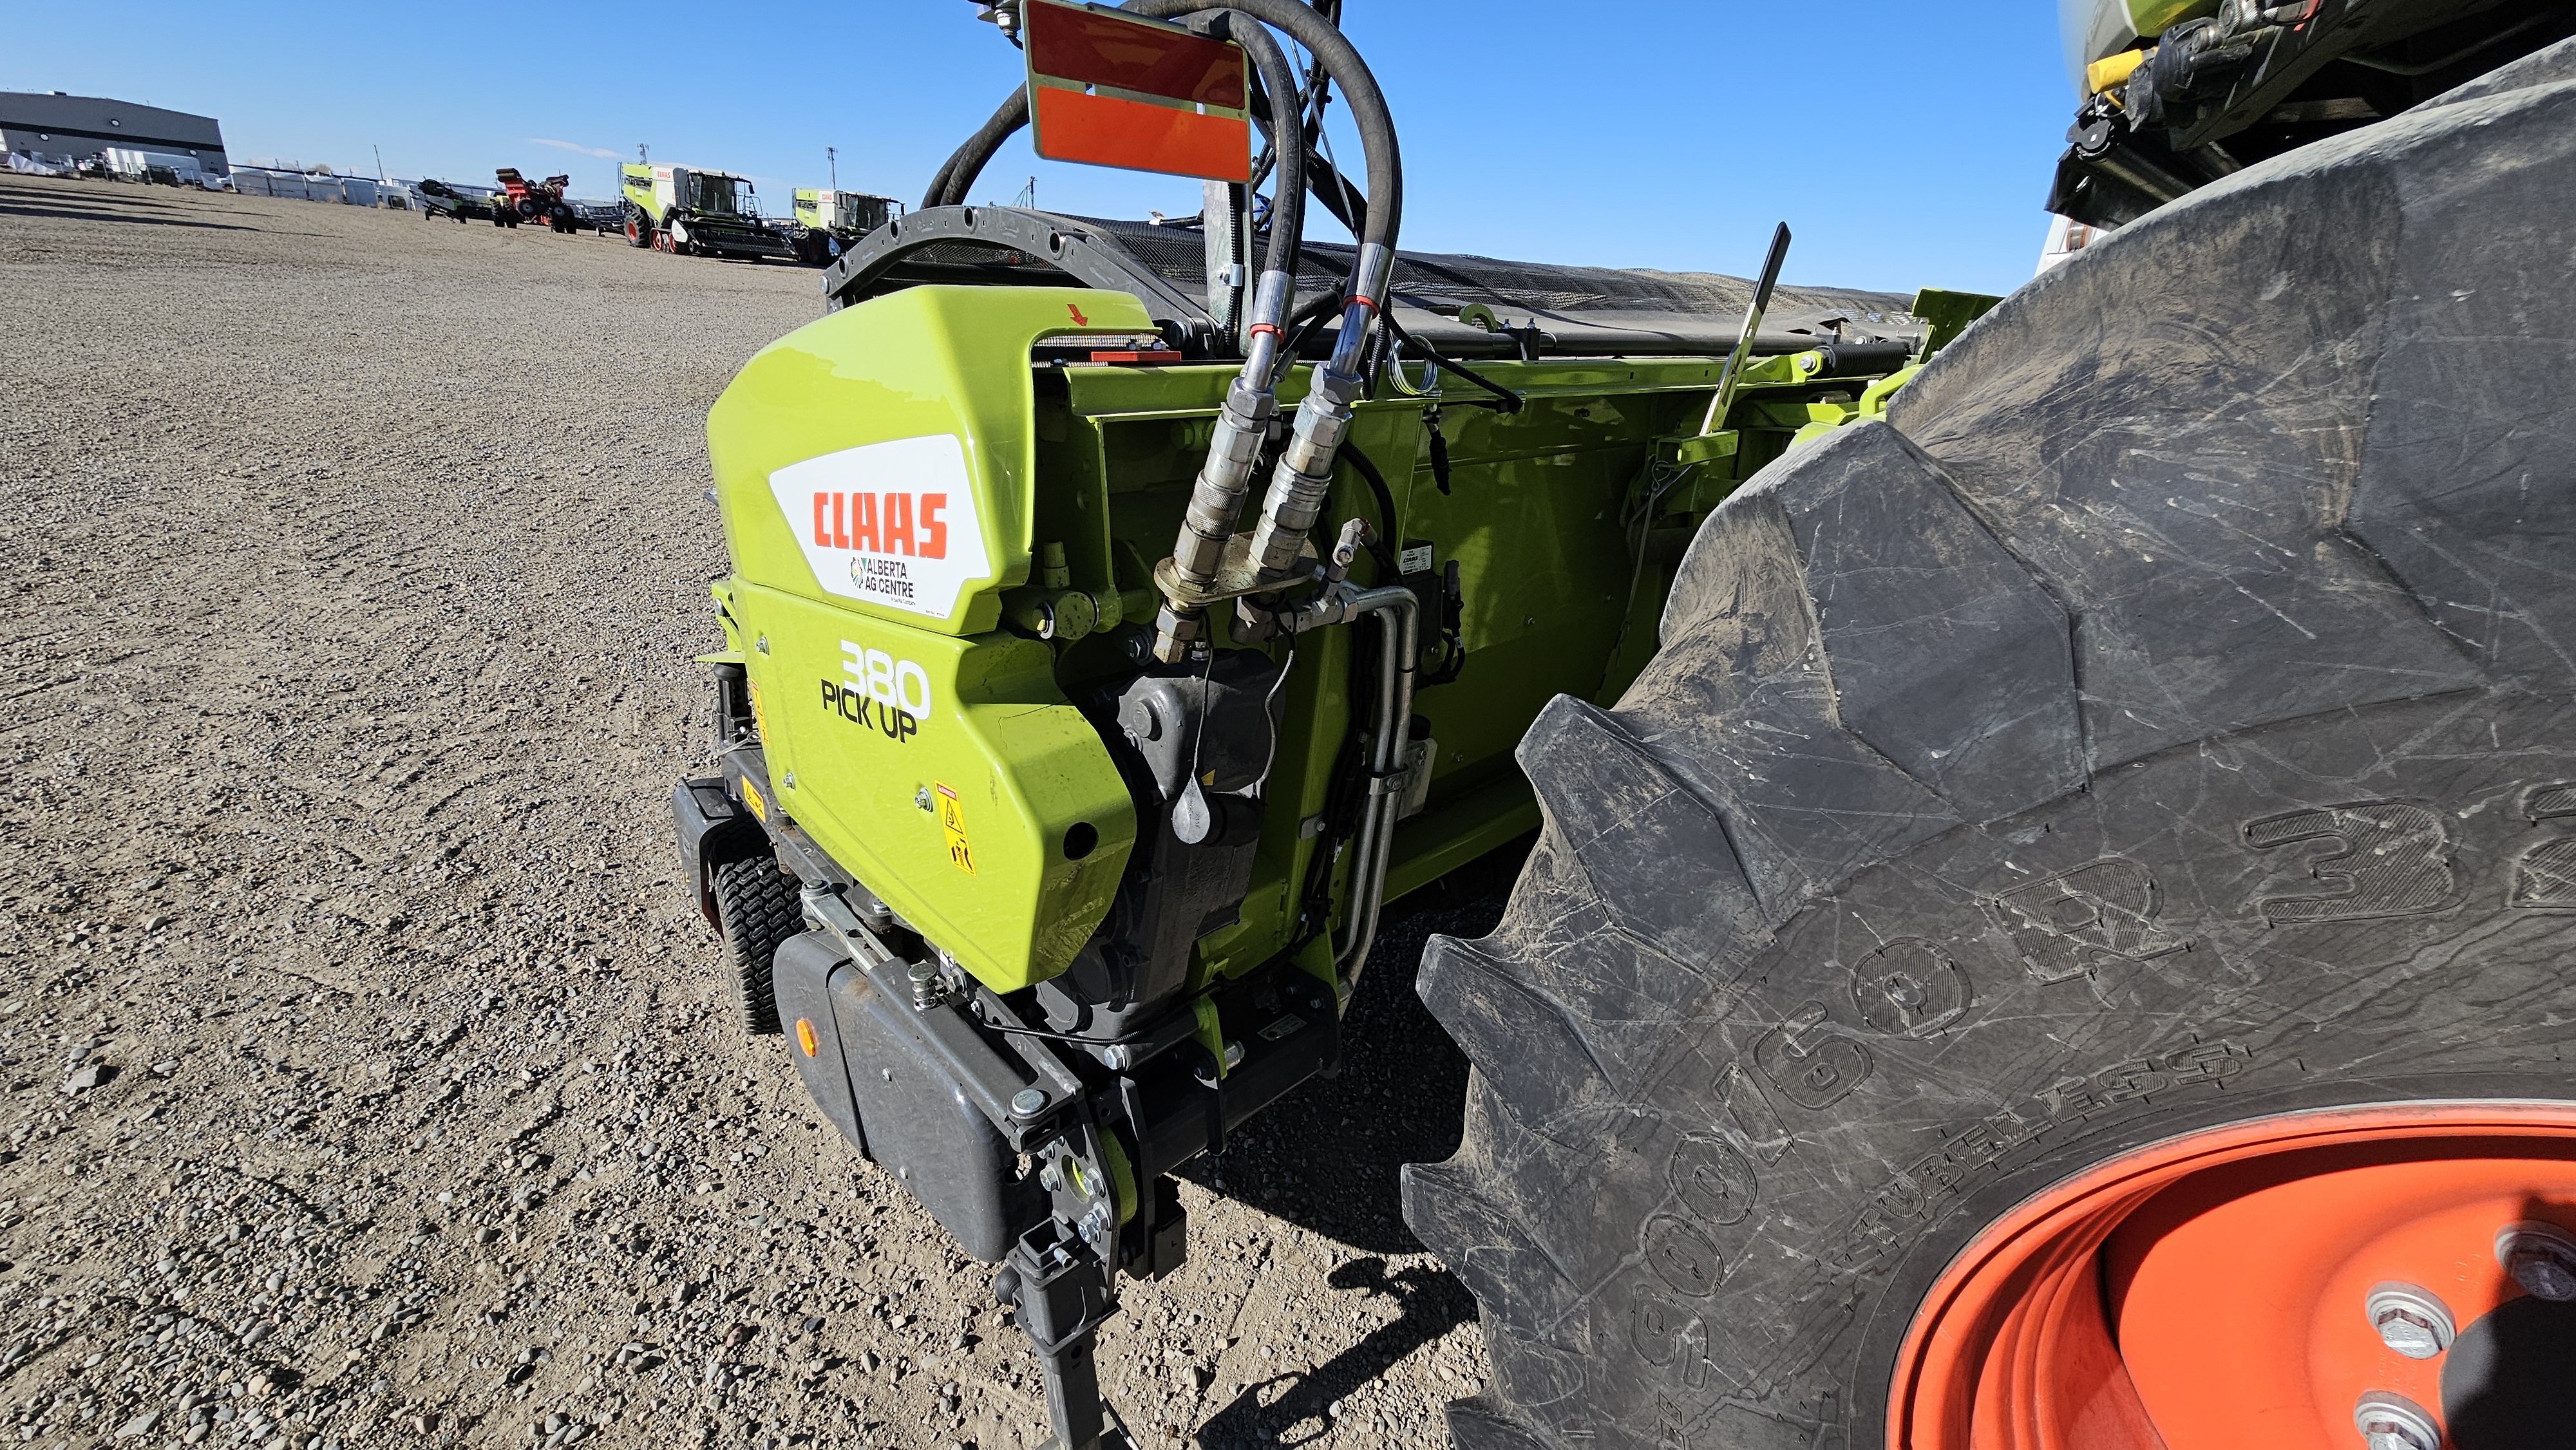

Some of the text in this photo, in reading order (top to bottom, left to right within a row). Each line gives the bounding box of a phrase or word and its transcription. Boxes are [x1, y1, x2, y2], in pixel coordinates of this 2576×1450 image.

[813, 492, 947, 560] CLAAS
[865, 576, 914, 598] AG CENTRE
[867, 558, 907, 579] ALBERTA
[820, 679, 918, 744] PICK UP
[840, 639, 931, 720] 380
[1993, 856, 2197, 985] R
[2240, 777, 2576, 927] 3
[1851, 1042, 2244, 1245] TUBELESS
